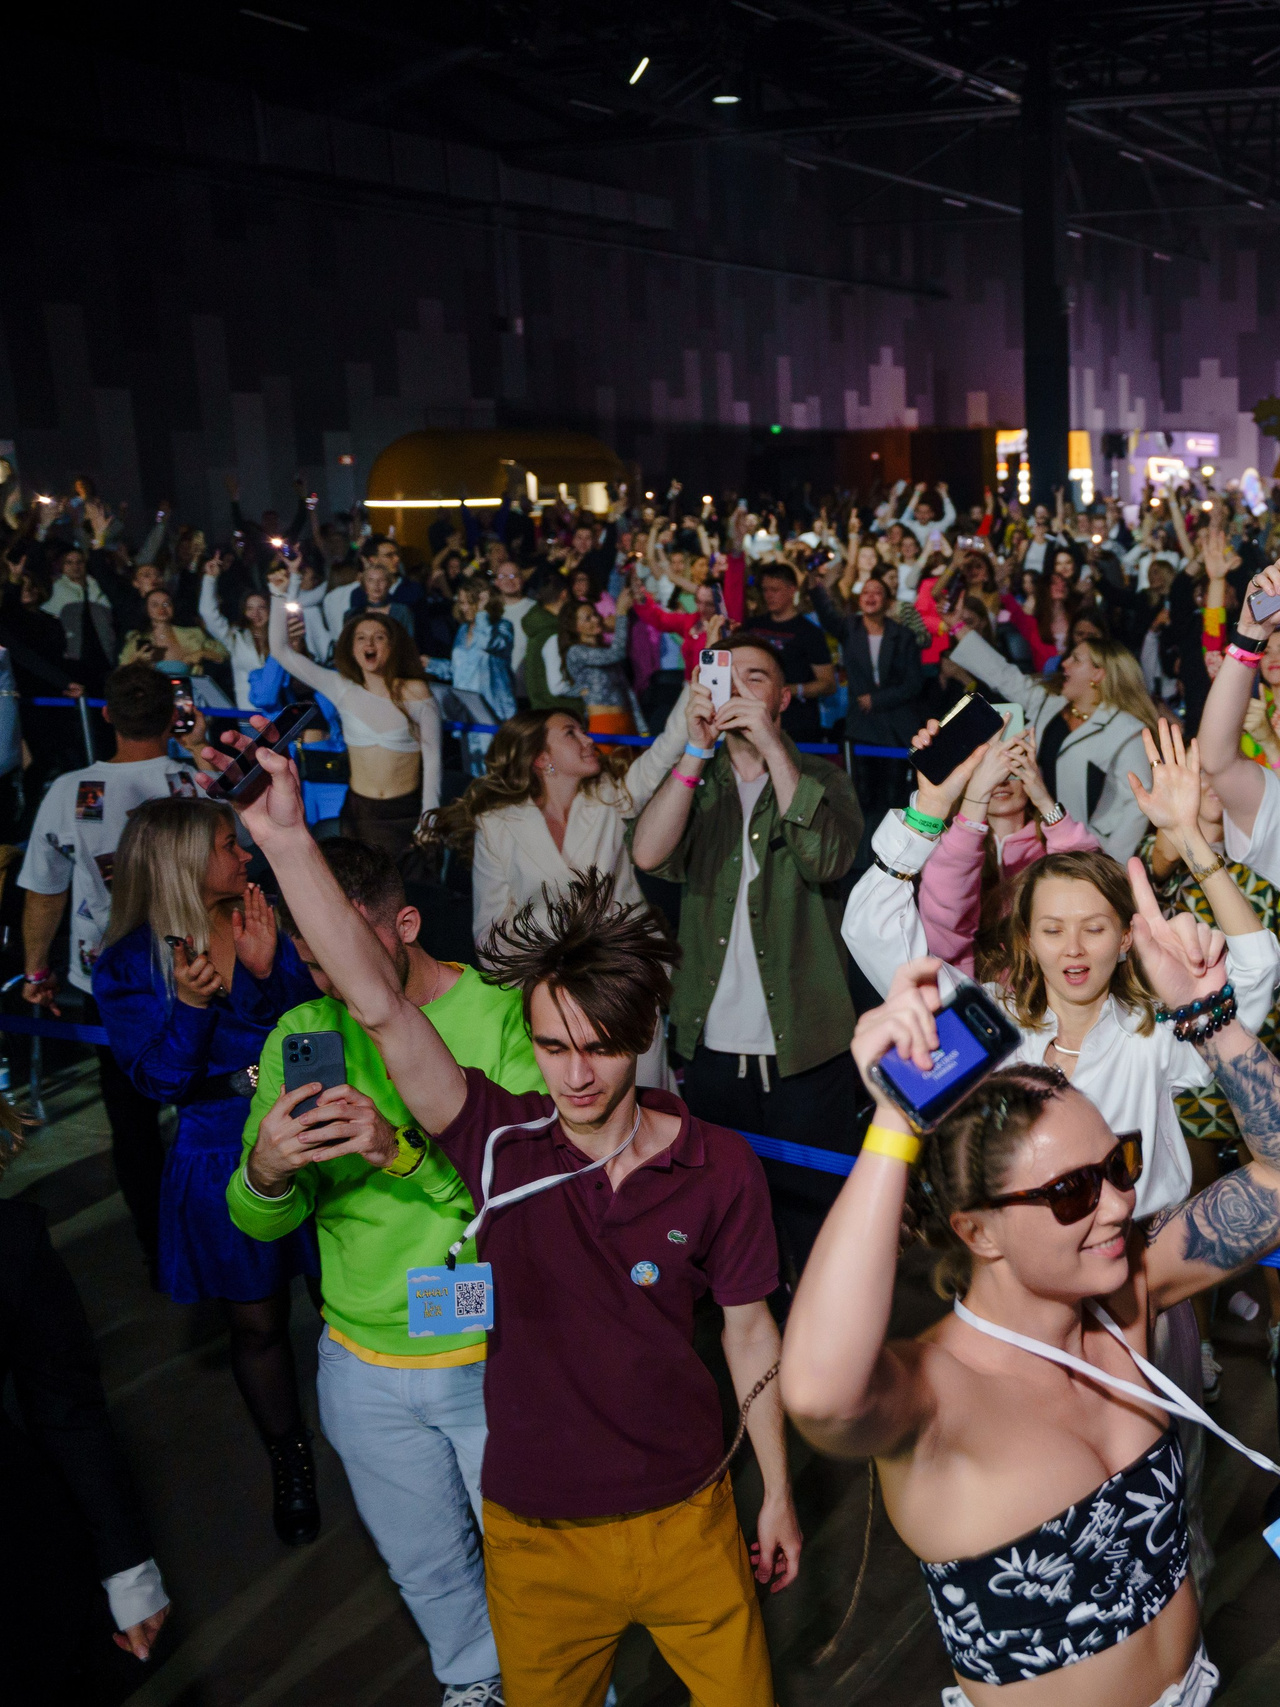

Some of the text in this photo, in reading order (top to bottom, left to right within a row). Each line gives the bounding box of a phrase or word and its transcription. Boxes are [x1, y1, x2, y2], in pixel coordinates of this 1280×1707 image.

[415, 1287, 449, 1299] КАНАЛ
[987, 1568, 1076, 1606] Cruella
[1090, 1537, 1130, 1599] Cruella
